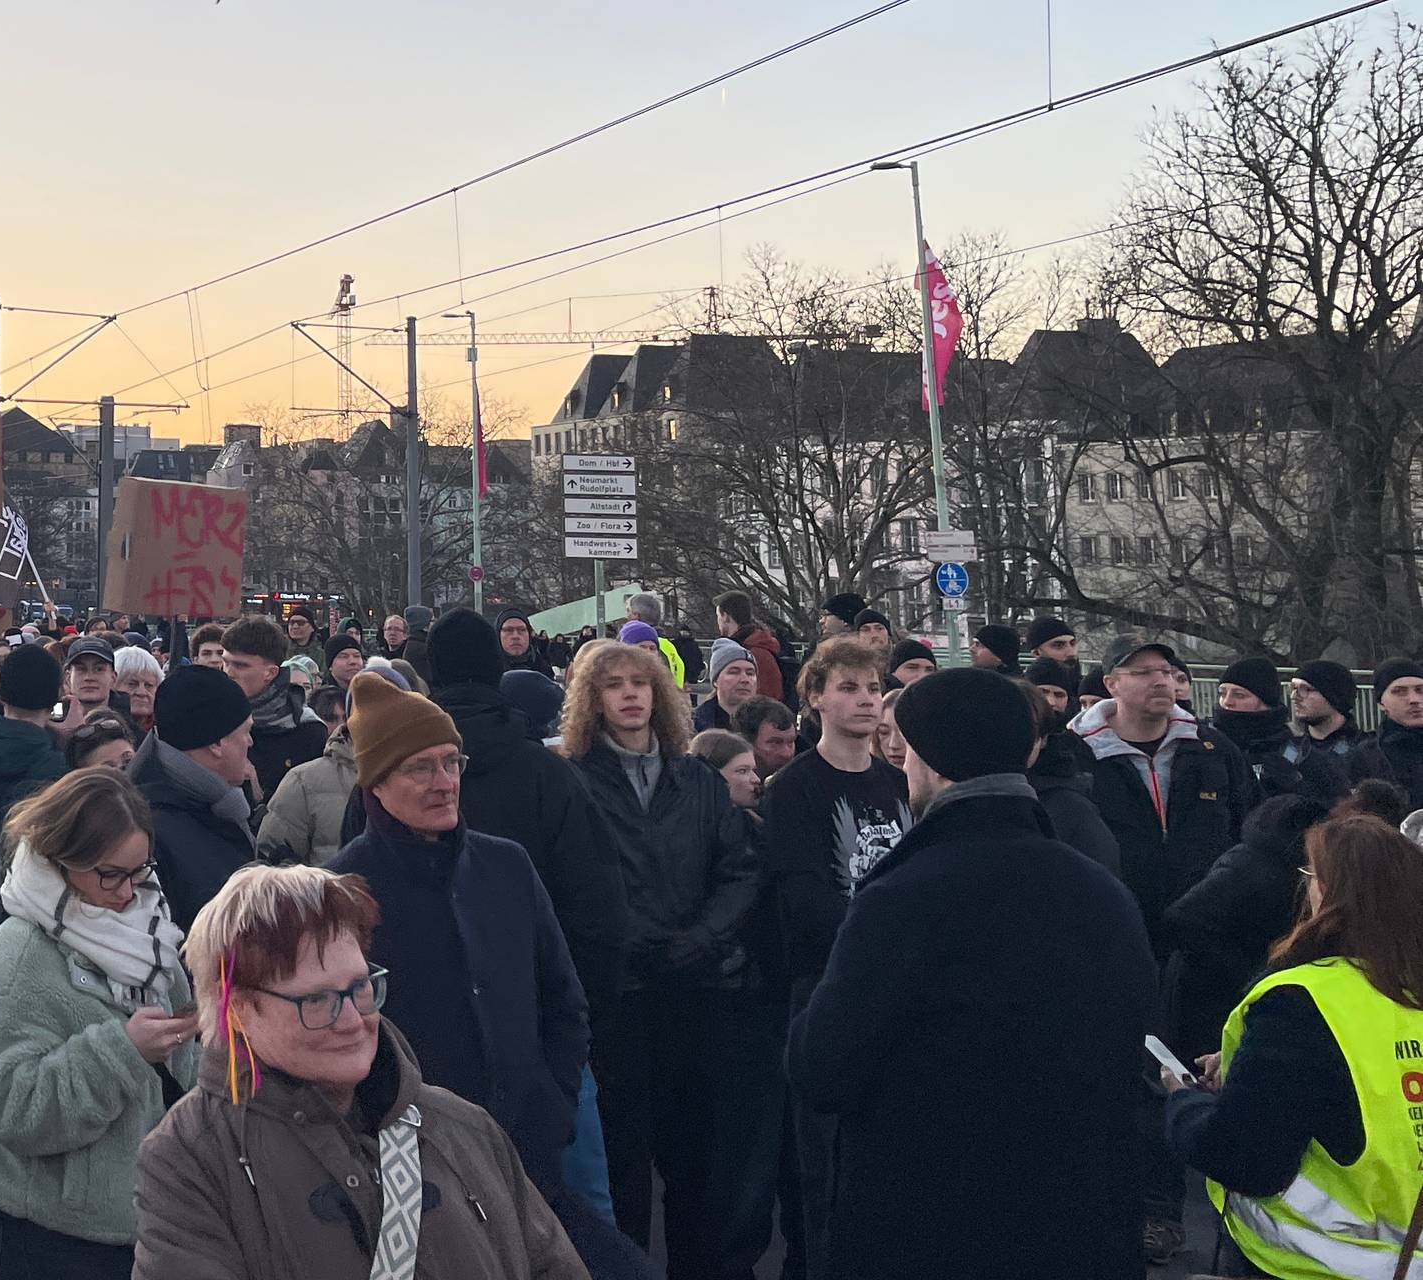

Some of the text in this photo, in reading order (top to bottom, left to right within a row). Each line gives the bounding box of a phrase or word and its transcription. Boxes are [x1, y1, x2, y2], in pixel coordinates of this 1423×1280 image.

[579, 459, 597, 467] Dom
[579, 476, 618, 484] Neumarkt
[579, 485, 623, 493] Rudolfplatz
[590, 502, 620, 511] Altstadt
[577, 521, 591, 529] Zoo
[600, 522, 621, 530] Flora
[573, 540, 621, 548] Handwerks-
[588, 548, 621, 557] kammer
